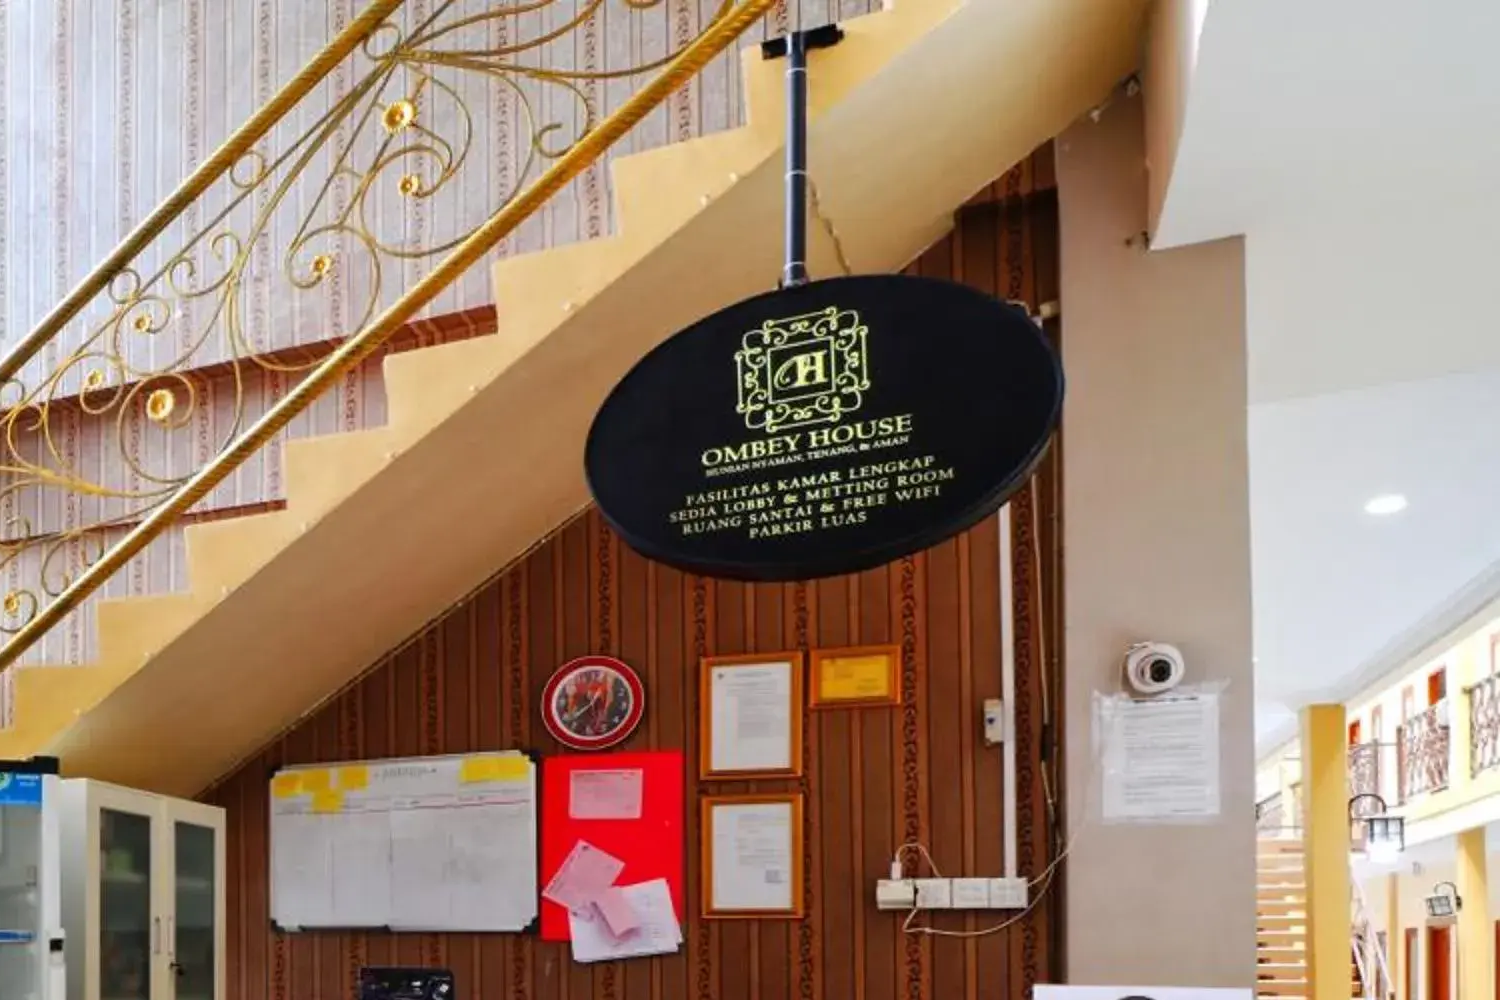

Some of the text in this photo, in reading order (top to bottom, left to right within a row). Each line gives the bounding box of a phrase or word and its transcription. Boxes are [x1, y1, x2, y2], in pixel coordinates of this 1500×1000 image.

[701, 414, 913, 467] OMBEY HOUSE
[872, 435, 910, 449] AMAN
[669, 505, 717, 524] SEDIA
[723, 495, 777, 515] LOBBY
[805, 477, 890, 501] METTING
[897, 467, 955, 487] ROOM
[685, 455, 936, 507] FASILITAS KAMAR LENGKAP
[682, 516, 742, 536] RUANG
[748, 504, 813, 526] SANTAI
[843, 492, 888, 510] FREE
[895, 484, 941, 501] WIFI
[748, 511, 869, 540] PARKIR LUAS
